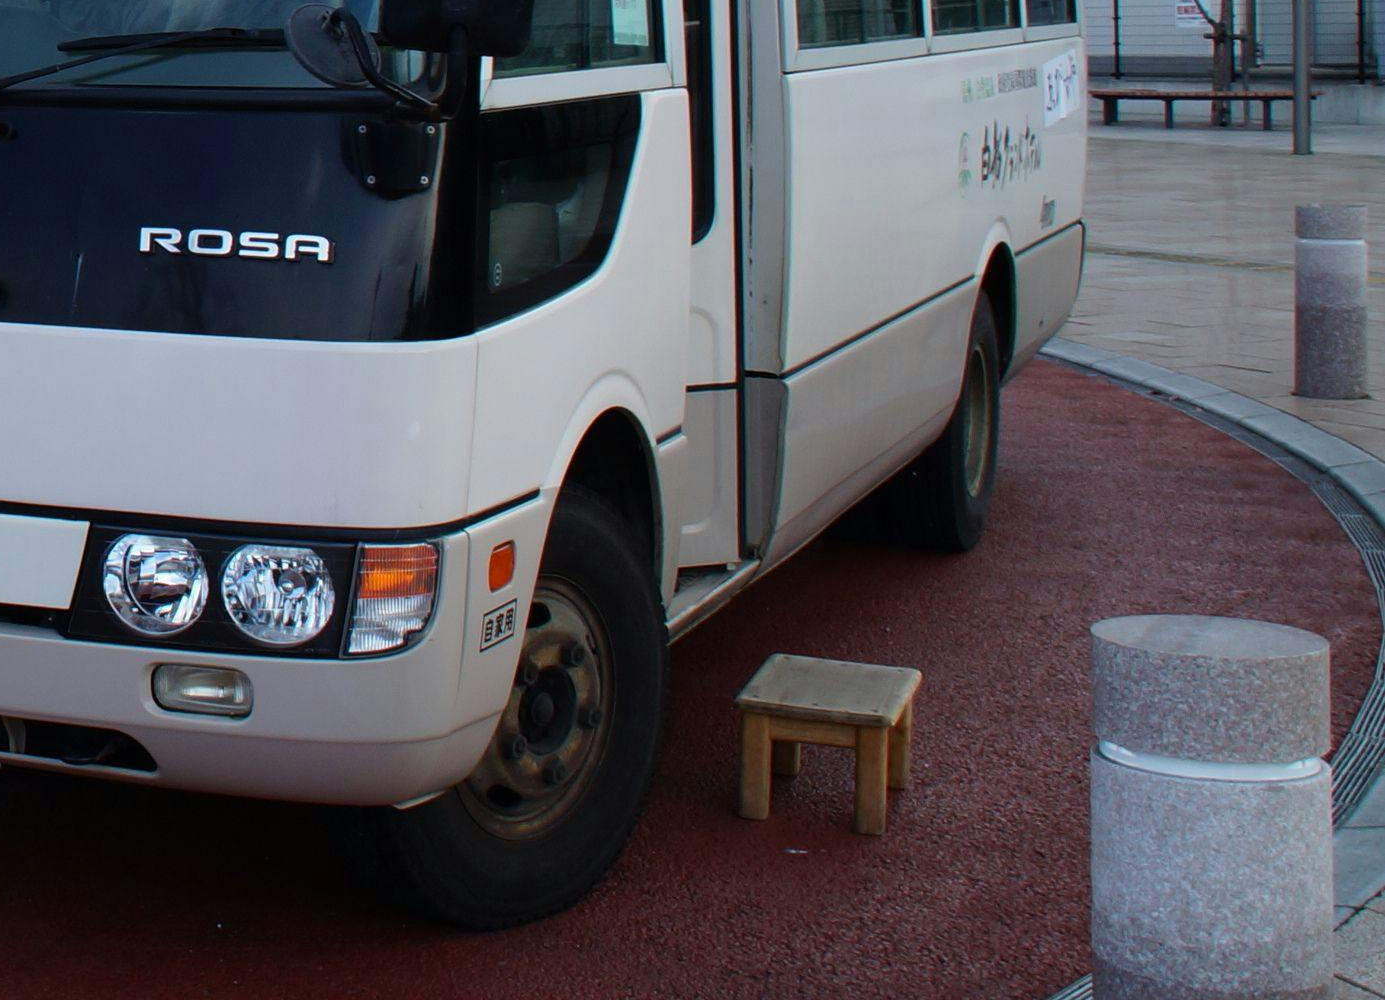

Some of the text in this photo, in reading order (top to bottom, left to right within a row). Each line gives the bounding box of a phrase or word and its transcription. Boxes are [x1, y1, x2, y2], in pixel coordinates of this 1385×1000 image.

[139, 226, 332, 263] ROSA
[484, 607, 514, 643] 自家用
